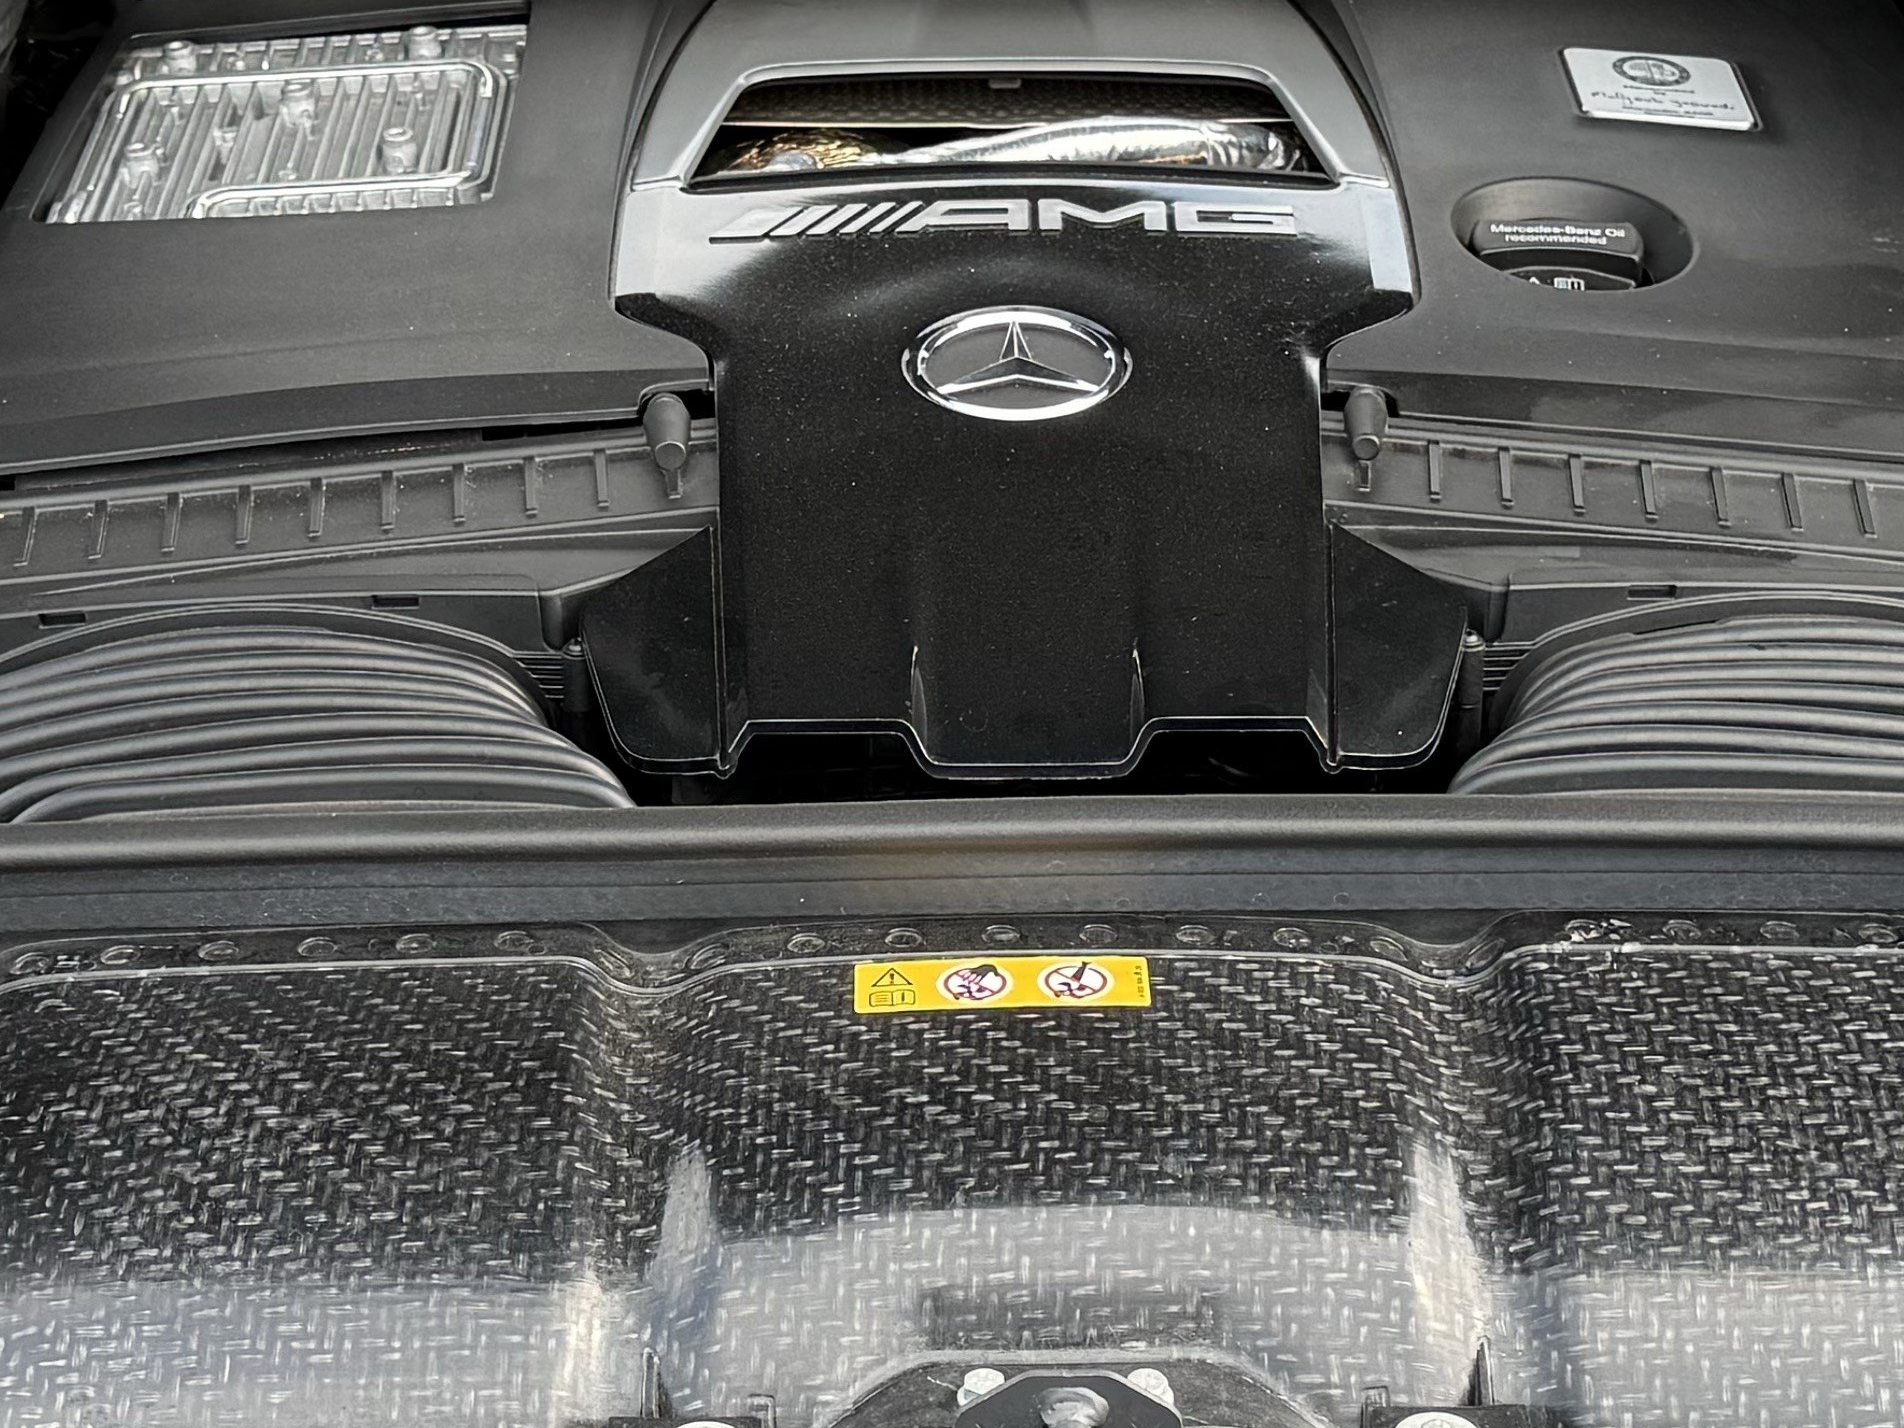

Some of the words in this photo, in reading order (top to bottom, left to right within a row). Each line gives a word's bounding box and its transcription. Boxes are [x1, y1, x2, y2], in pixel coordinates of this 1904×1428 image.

[896, 198, 1298, 235] AMG
[1490, 223, 1602, 236] Mercedes-Benz
[1605, 227, 1625, 238] Oil
[1504, 233, 1607, 245] recommended
